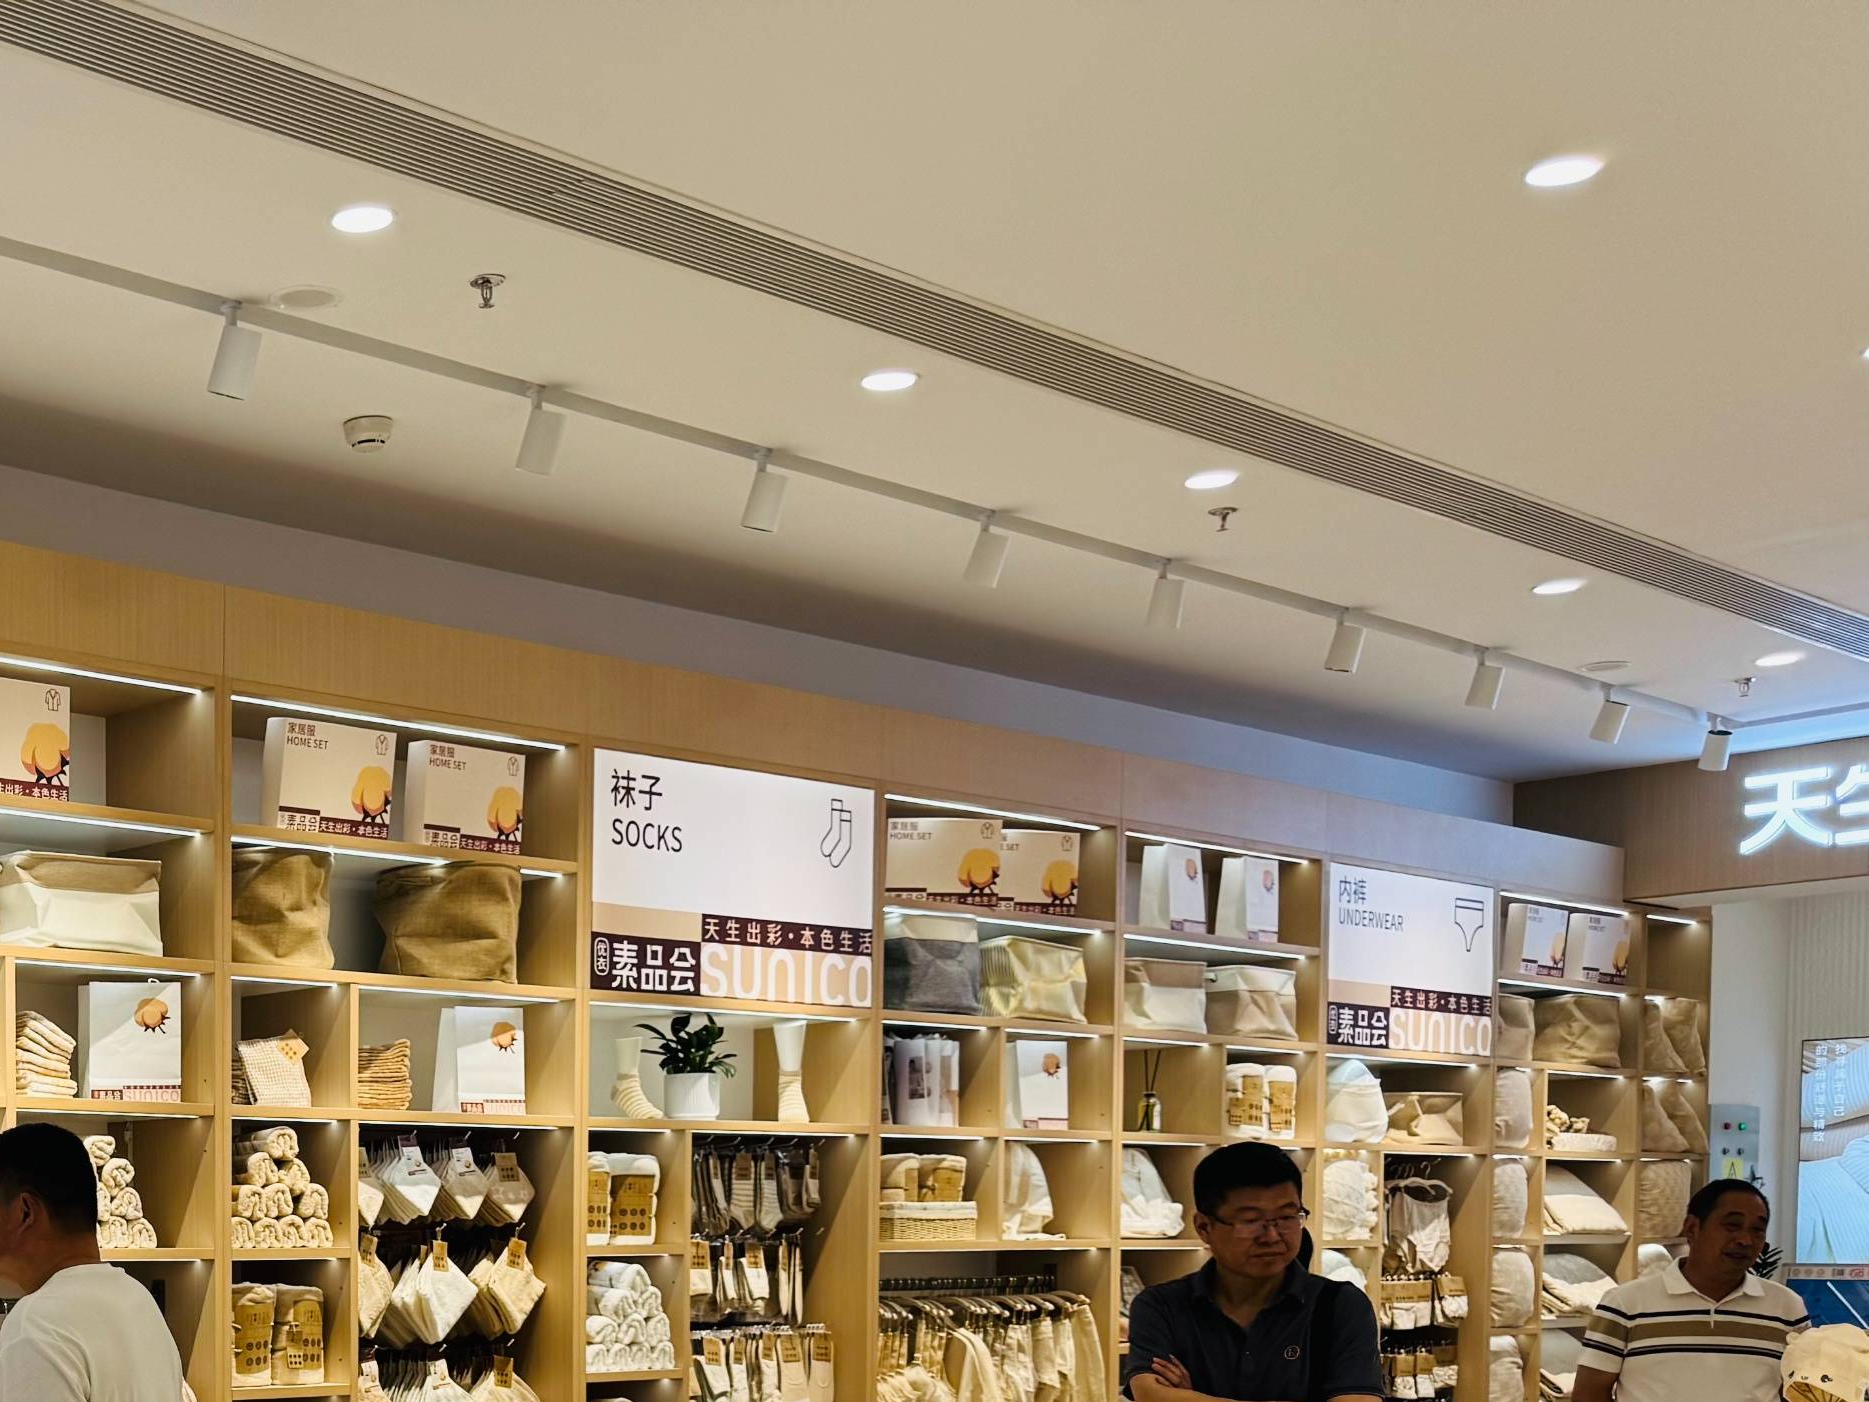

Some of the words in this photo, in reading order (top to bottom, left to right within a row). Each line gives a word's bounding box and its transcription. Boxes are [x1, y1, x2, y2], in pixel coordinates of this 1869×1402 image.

[286, 735, 312, 749] HOME
[313, 739, 329, 750] SET
[287, 721, 317, 737] 家居服
[429, 757, 452, 770] HOME
[453, 761, 467, 771] SET
[610, 768, 664, 812] 袜子
[611, 817, 683, 854] SOCKS
[889, 832, 915, 841] HOME
[916, 832, 932, 840] SET
[1338, 875, 1368, 905] 内裤
[1338, 907, 1404, 932] UNDERWEAR
[611, 941, 698, 993] 素品会
[1337, 1006, 1388, 1047] 素品会
